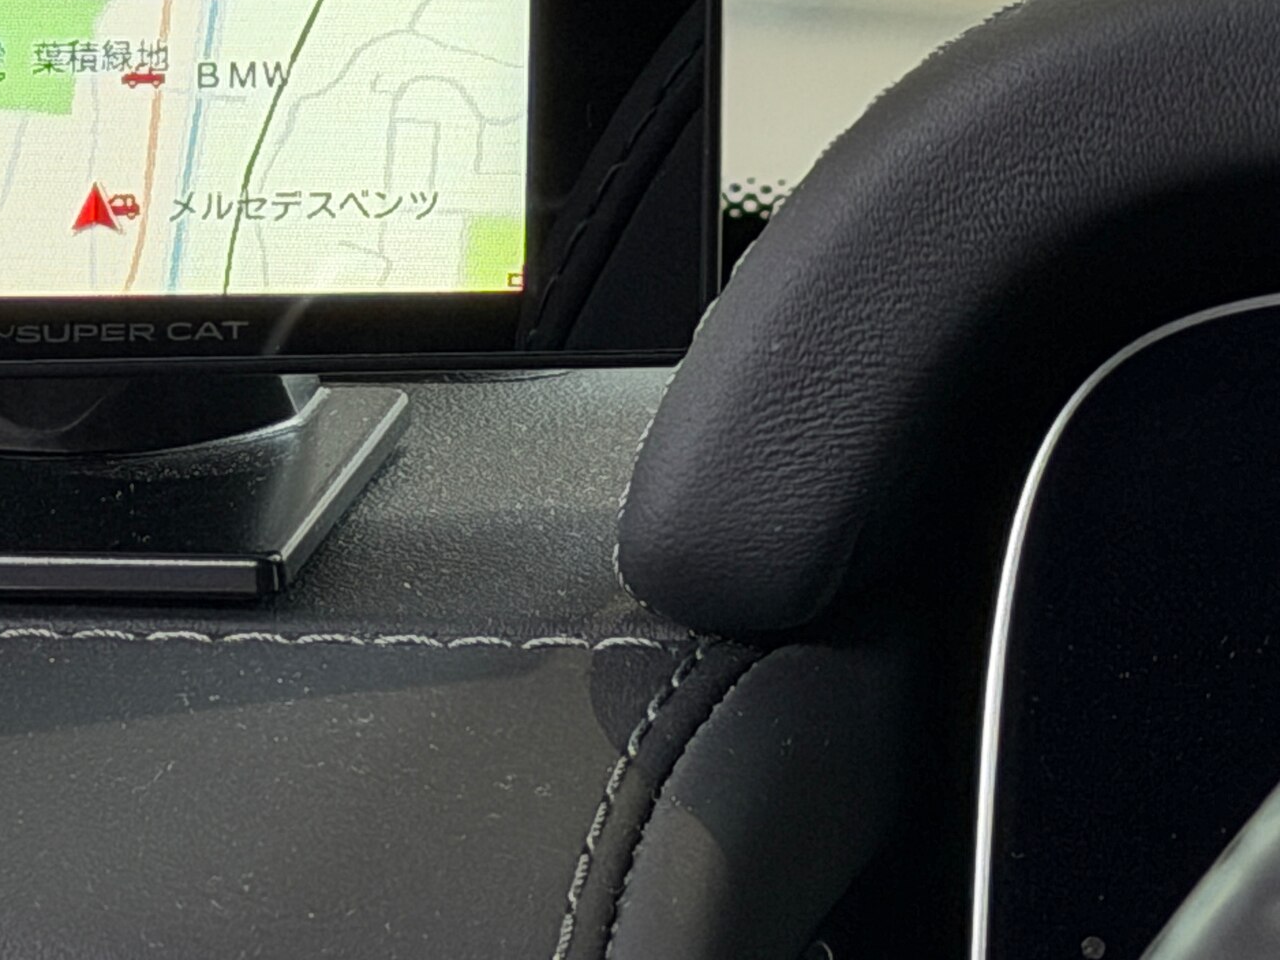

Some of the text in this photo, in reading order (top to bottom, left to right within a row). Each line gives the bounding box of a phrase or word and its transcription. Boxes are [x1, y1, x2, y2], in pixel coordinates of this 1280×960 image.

[32, 39, 169, 74] 葉積緑地
[196, 60, 289, 90] BMW
[169, 190, 439, 223] メルセデスベンツ
[15, 320, 249, 343] SUPER CAT
